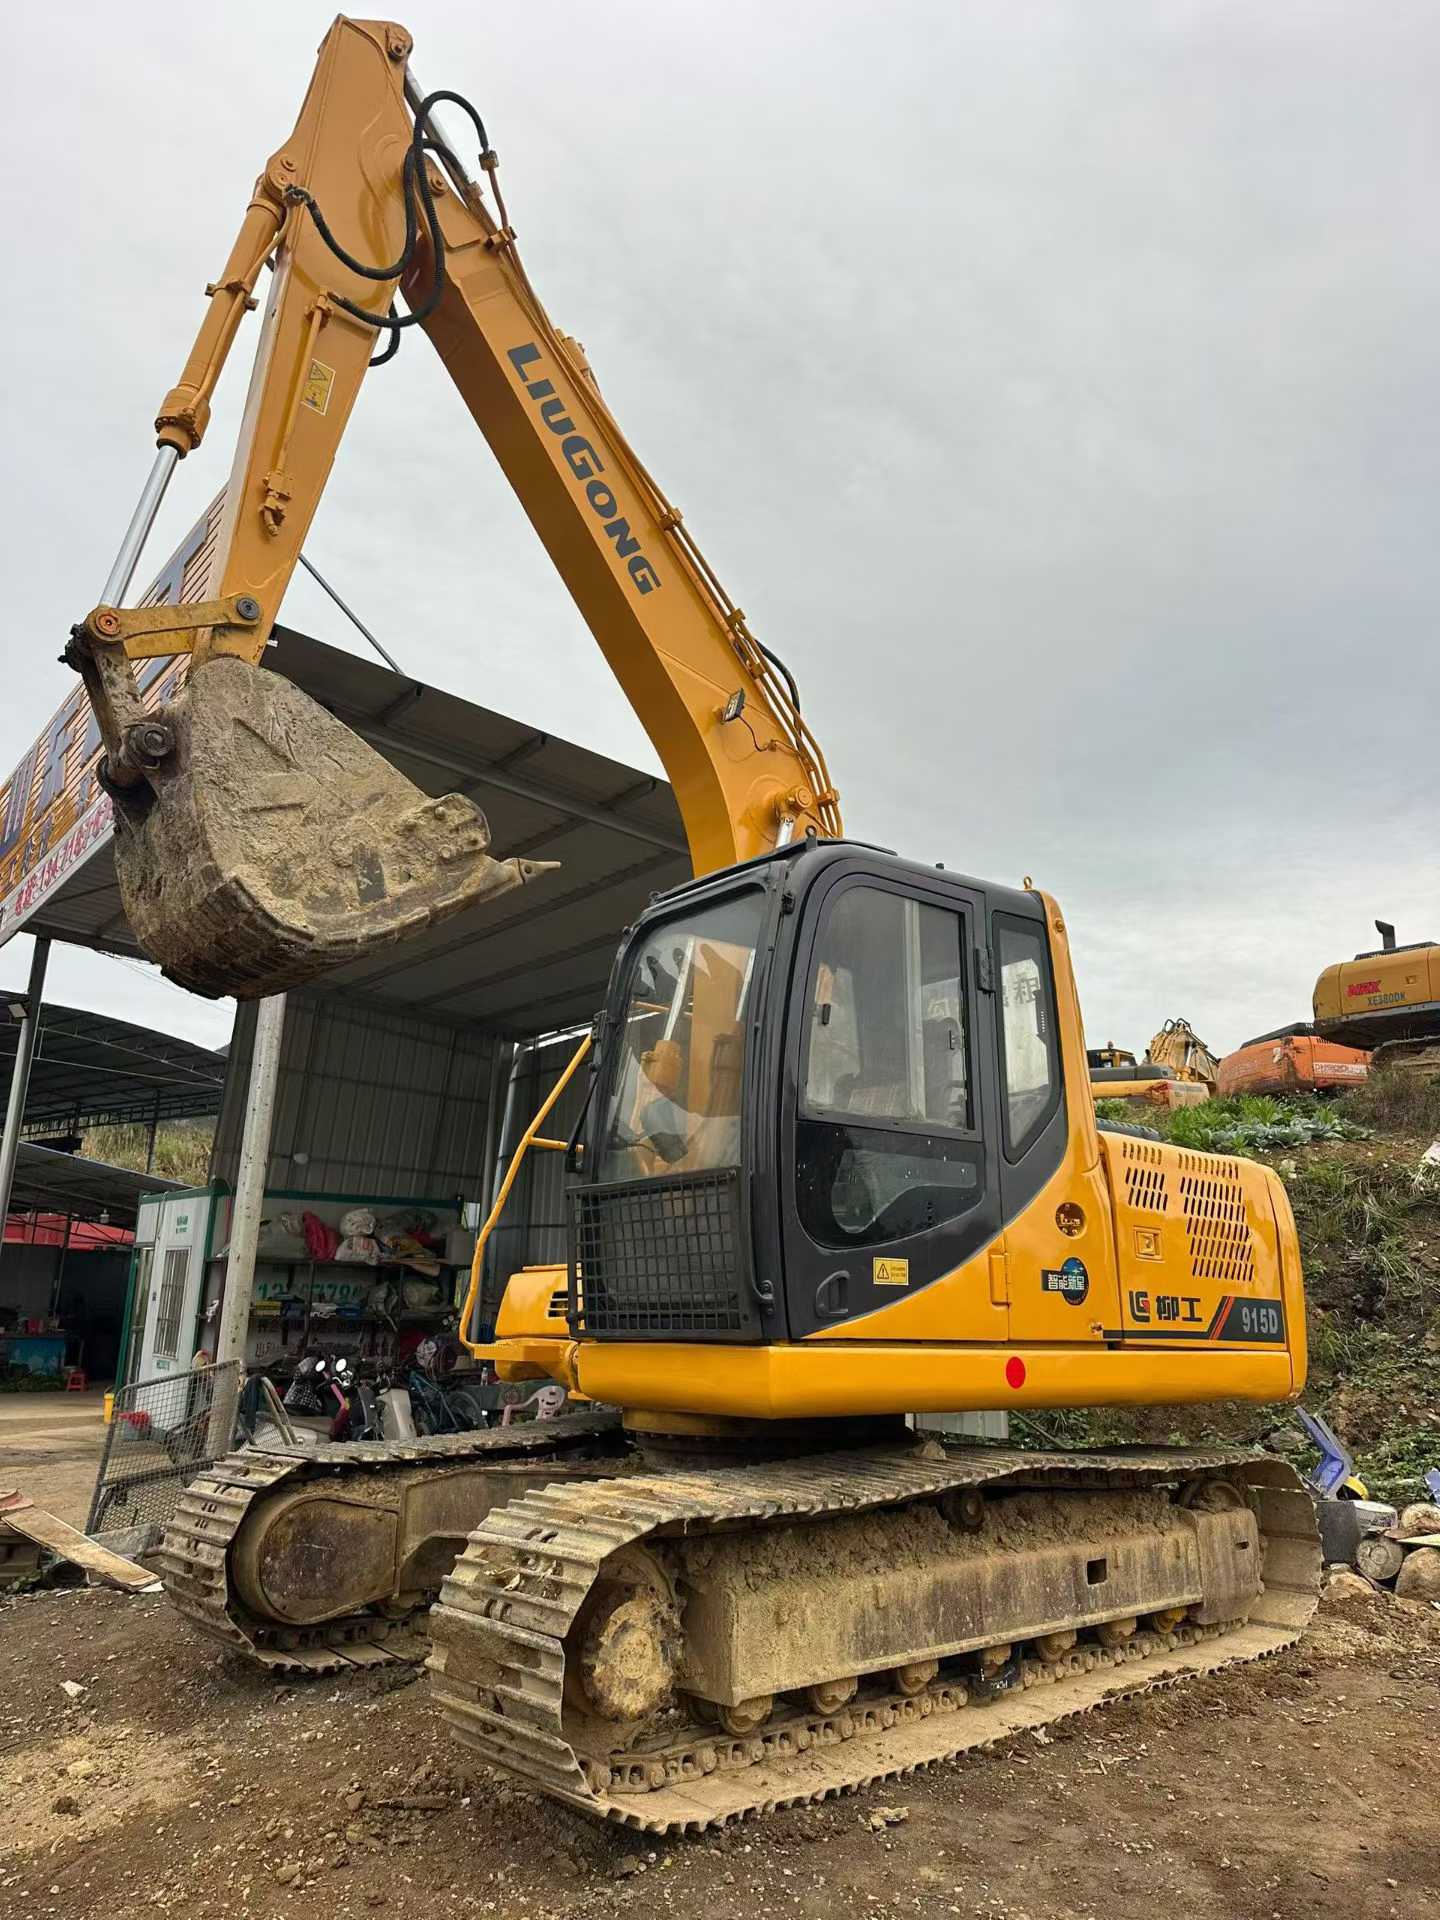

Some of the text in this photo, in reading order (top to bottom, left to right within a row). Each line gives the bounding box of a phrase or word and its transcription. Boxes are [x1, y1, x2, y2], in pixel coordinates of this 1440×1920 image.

[506, 342, 662, 596] LIUGONG
[1155, 1295, 1203, 1322] 柳工
[1241, 1306, 1279, 1335] 915D
